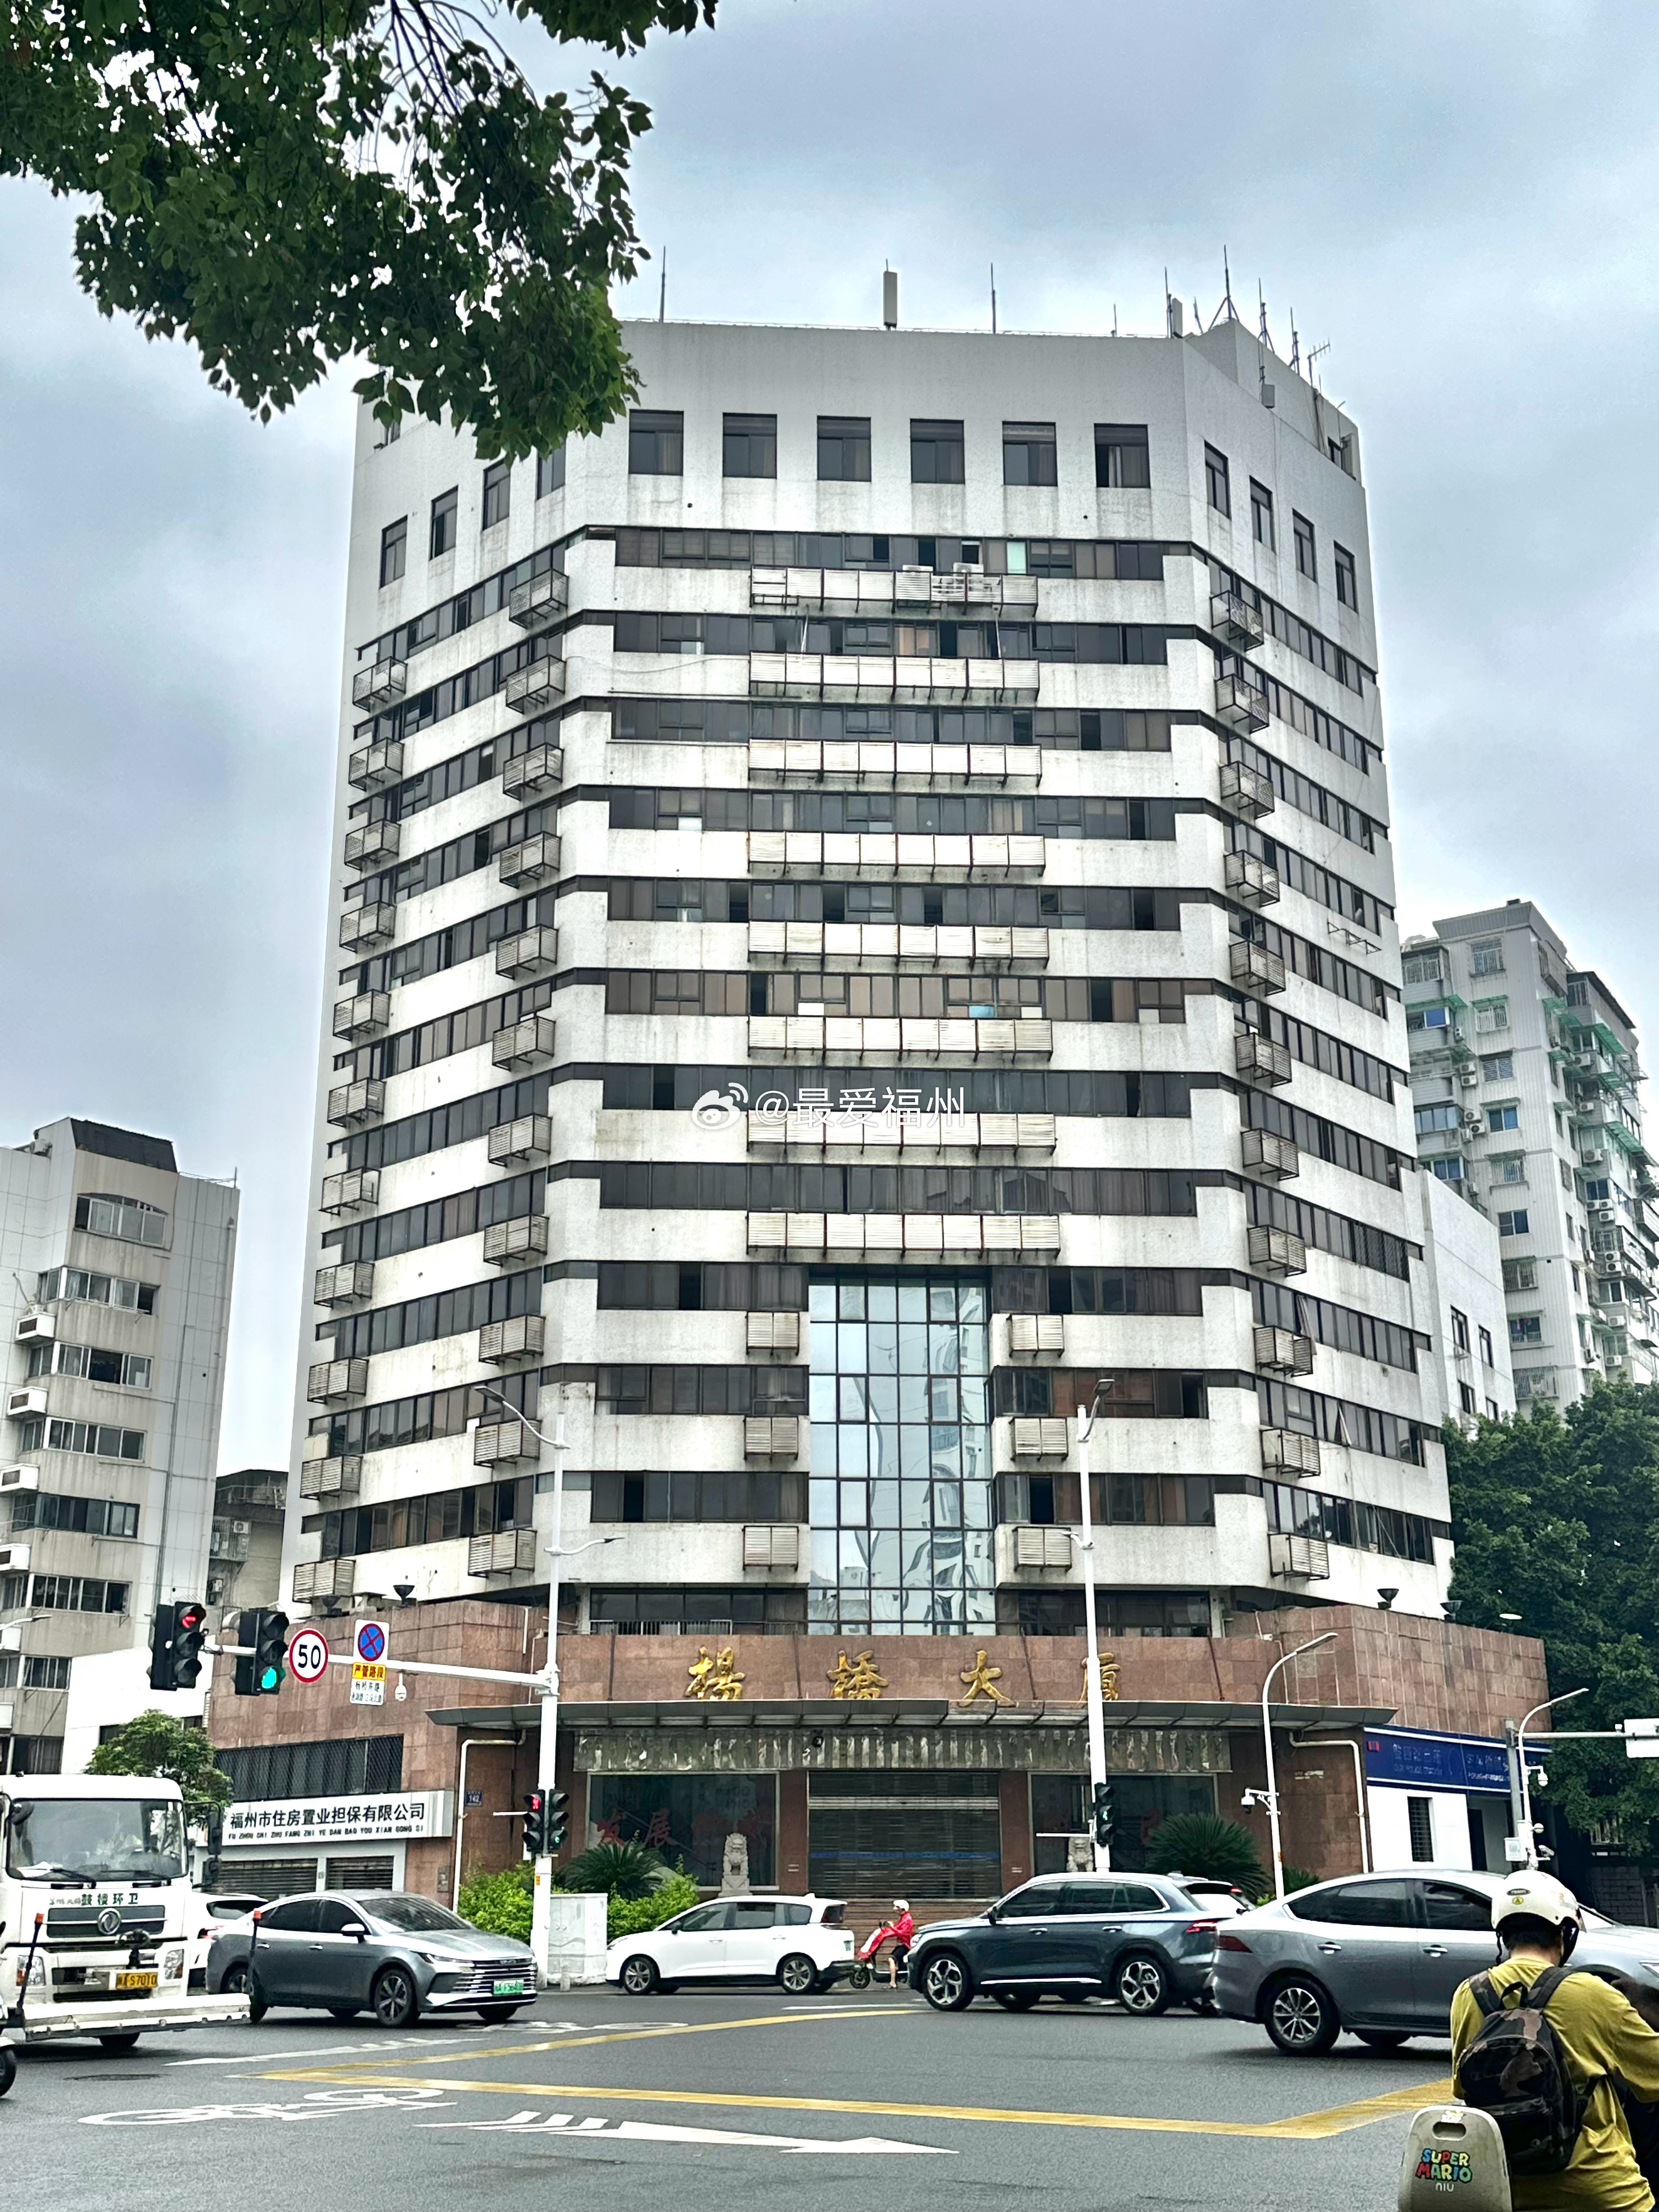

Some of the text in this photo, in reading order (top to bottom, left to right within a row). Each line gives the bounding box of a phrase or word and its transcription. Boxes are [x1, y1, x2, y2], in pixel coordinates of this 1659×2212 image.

[298, 1644, 321, 1669] 50
[230, 1803, 425, 1829] 福州市住房置业担保有限公司
[1421, 2148, 1470, 2167] SUPER
[1415, 2161, 1473, 2183] MARIO
